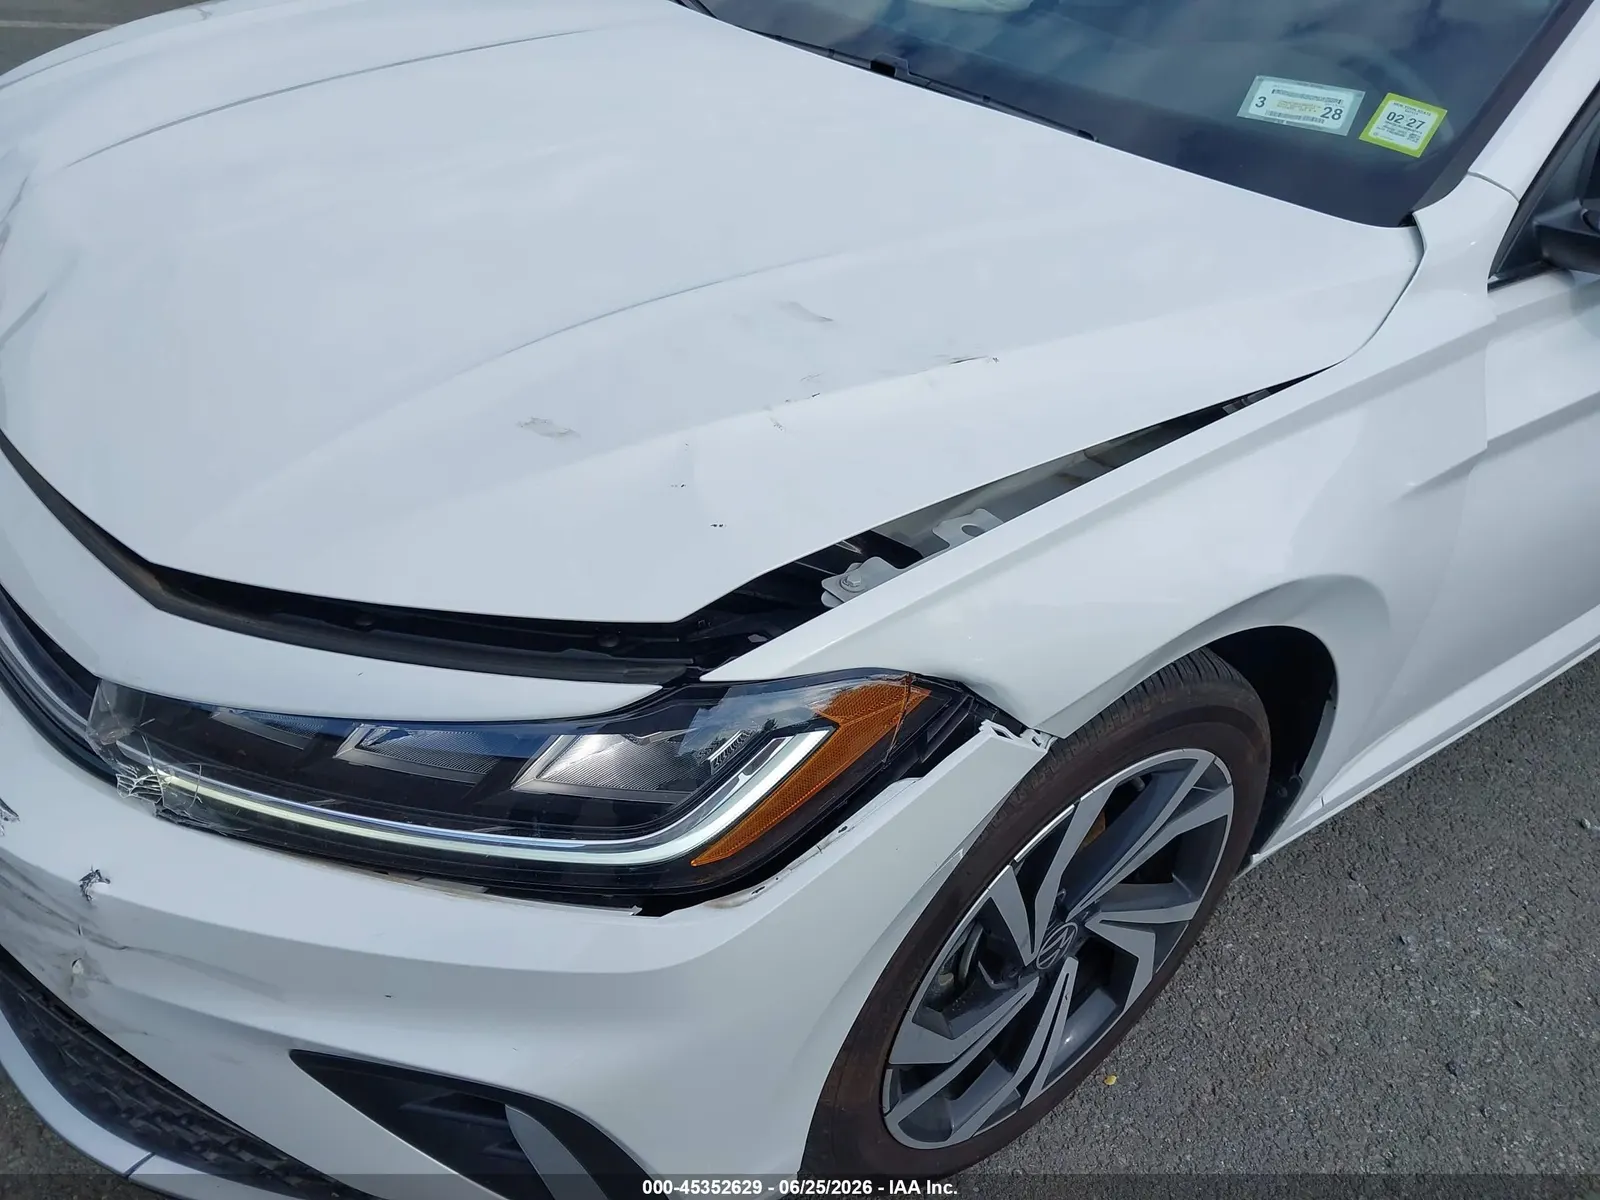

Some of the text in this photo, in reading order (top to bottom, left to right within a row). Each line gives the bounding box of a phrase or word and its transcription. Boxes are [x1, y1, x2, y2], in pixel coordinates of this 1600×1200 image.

[1255, 96, 1267, 108] 3
[1320, 106, 1343, 121] 28
[1386, 111, 1404, 124] 02
[1406, 118, 1426, 130] 27
